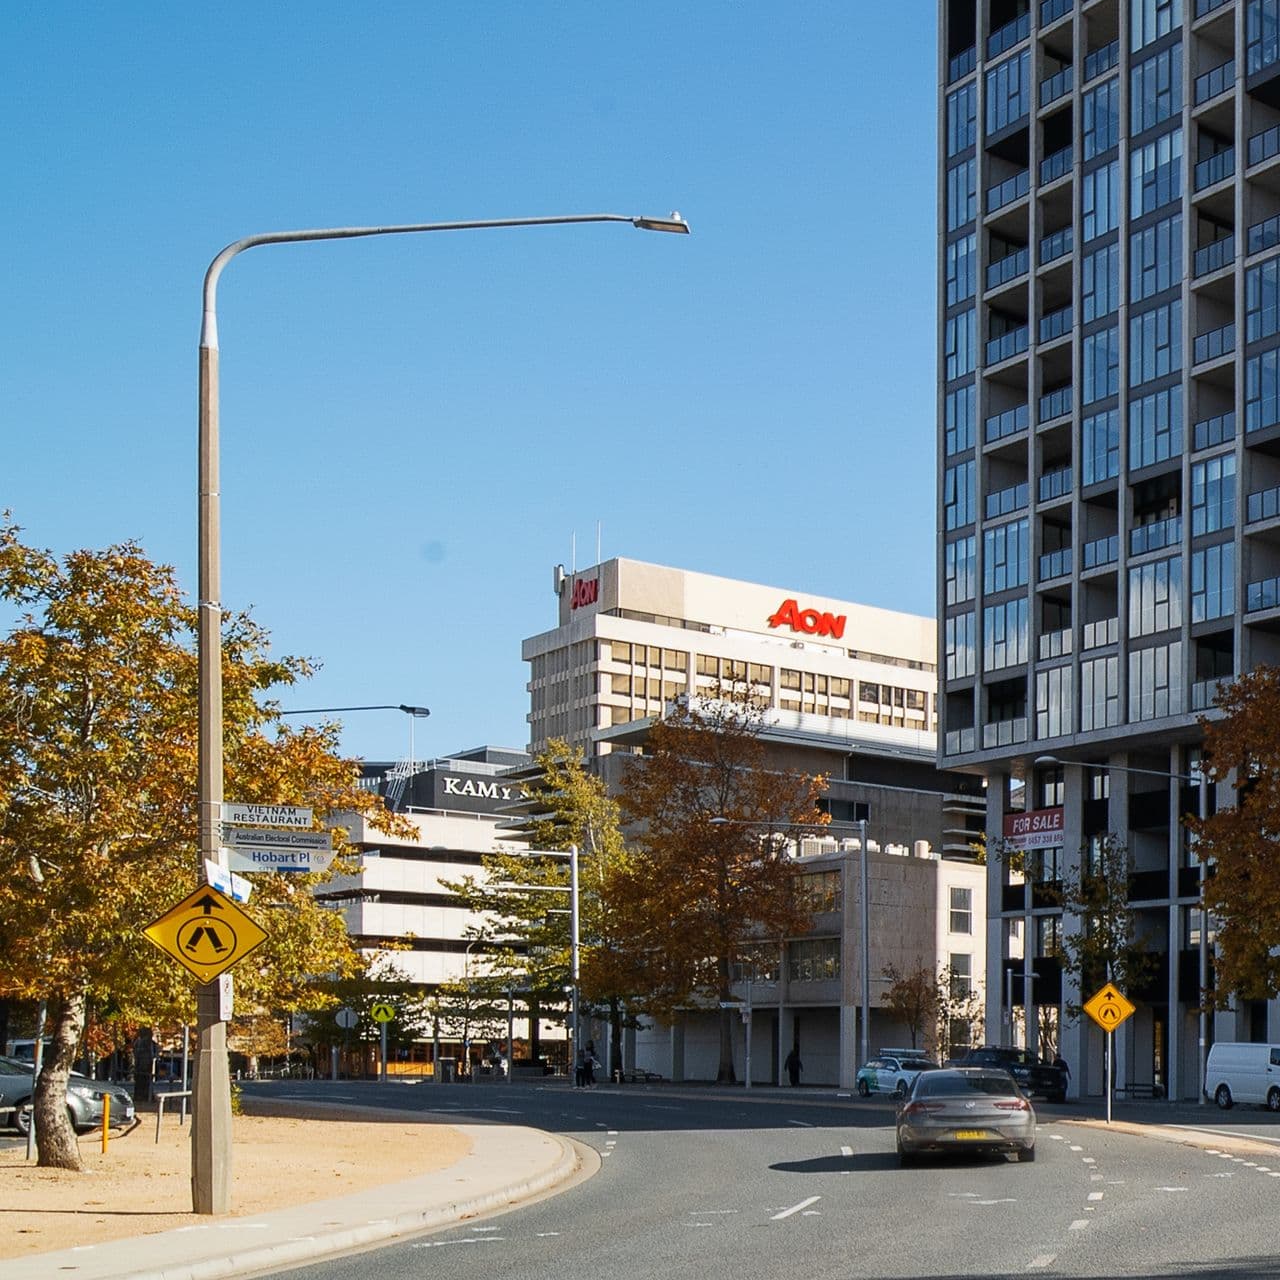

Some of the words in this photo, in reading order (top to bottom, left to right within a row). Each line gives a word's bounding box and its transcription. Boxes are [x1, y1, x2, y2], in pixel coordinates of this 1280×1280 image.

[247, 805, 297, 815] VIETNAM
[233, 814, 308, 826] RESTAURANT
[1012, 817, 1031, 833] FOR
[1032, 813, 1060, 831] SALE
[235, 833, 265, 842] Australian
[252, 851, 296, 863] Hobart
[299, 852, 310, 863] Pl
